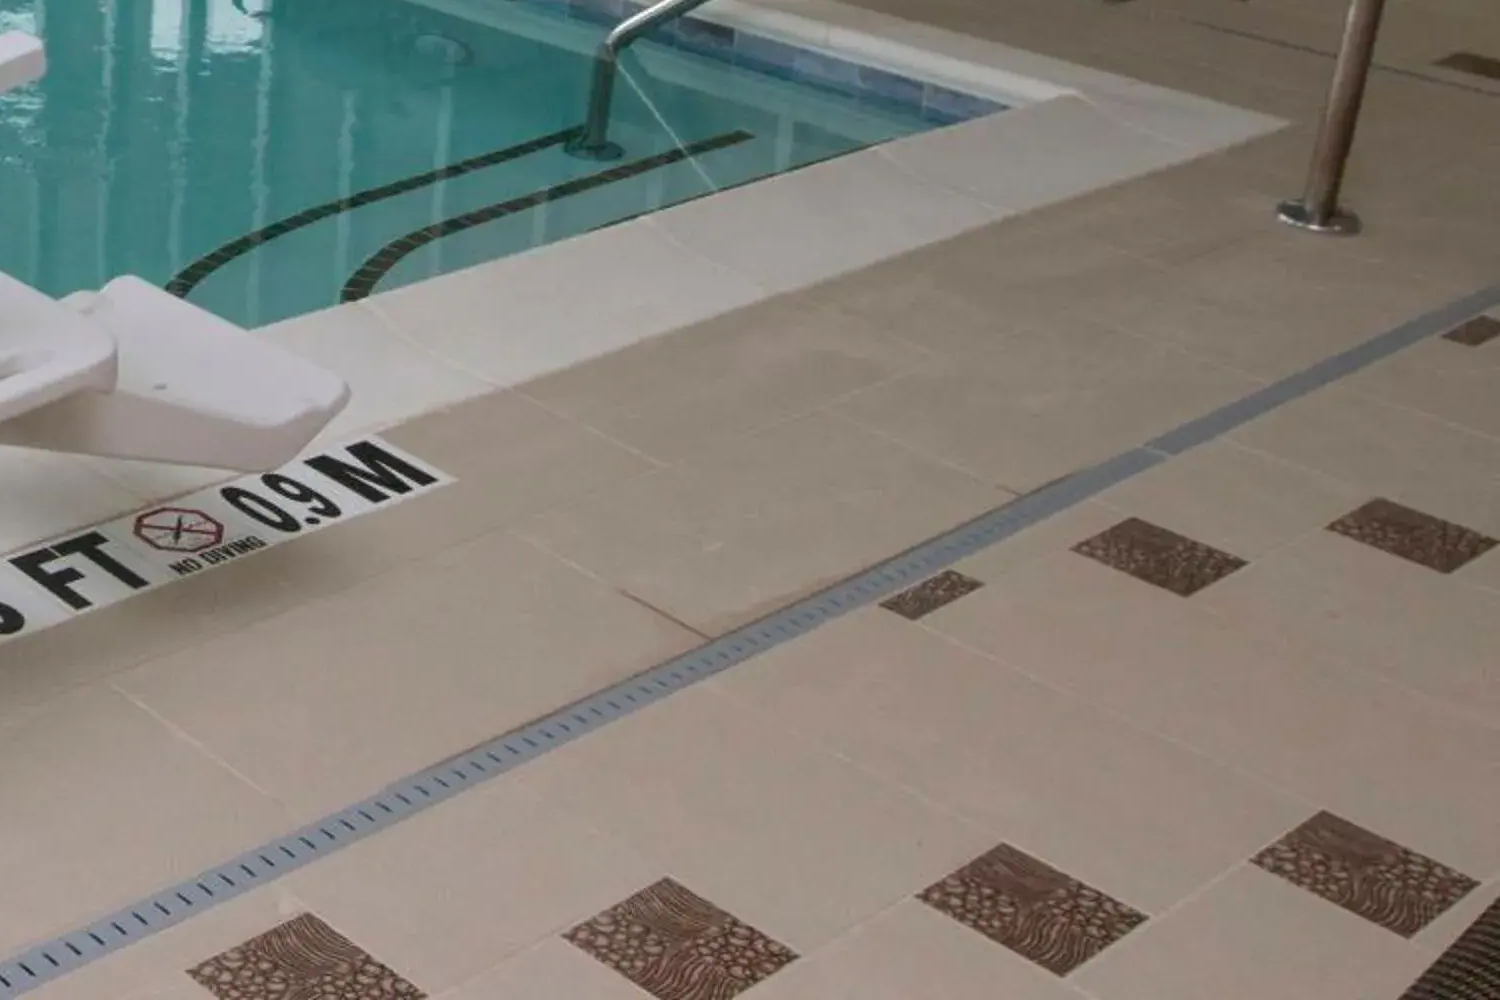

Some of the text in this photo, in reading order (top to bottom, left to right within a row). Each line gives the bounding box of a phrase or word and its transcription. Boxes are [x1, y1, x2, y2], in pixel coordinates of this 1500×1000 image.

[8, 531, 149, 611] FT
[220, 472, 342, 533] 0.9
[303, 440, 438, 503] M
[168, 535, 267, 576] NO DIVING
